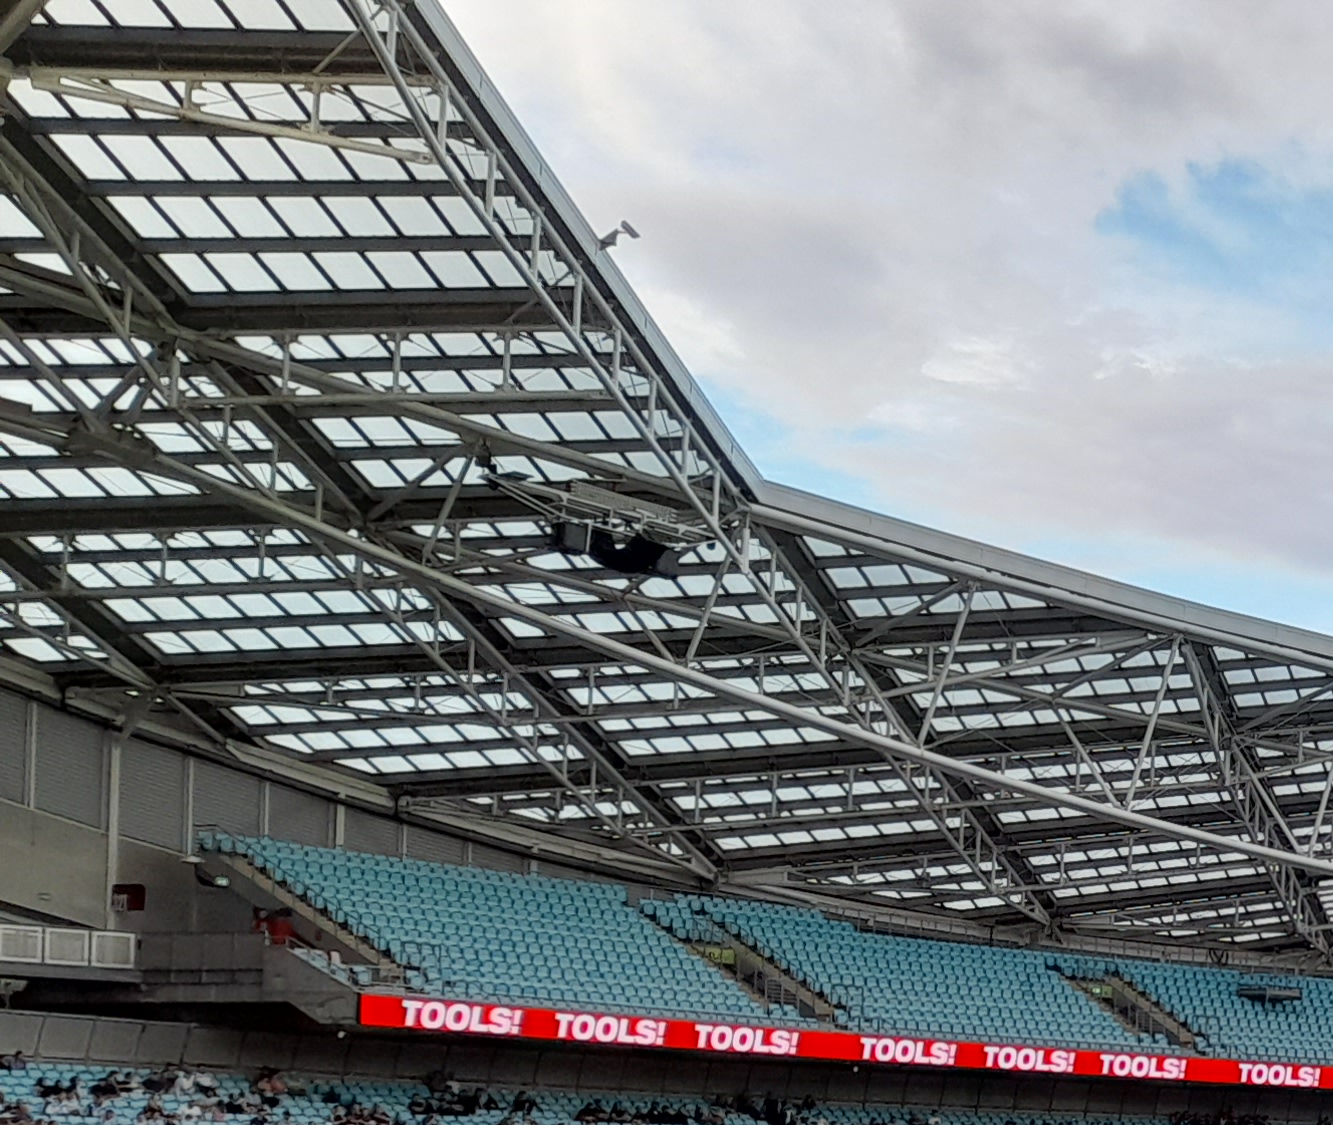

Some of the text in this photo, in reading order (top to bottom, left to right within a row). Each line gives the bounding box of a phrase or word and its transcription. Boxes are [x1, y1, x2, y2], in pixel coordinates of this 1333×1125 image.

[401, 999, 523, 1035] TOOLS!
[555, 1012, 667, 1046] TOOLS!
[694, 1023, 800, 1055] TOOLS!
[860, 1037, 957, 1065] TOOLS!
[983, 1045, 1076, 1073] TOOLS!
[1099, 1053, 1187, 1079] TOOLS!
[1238, 1063, 1321, 1087] TOOLS!
